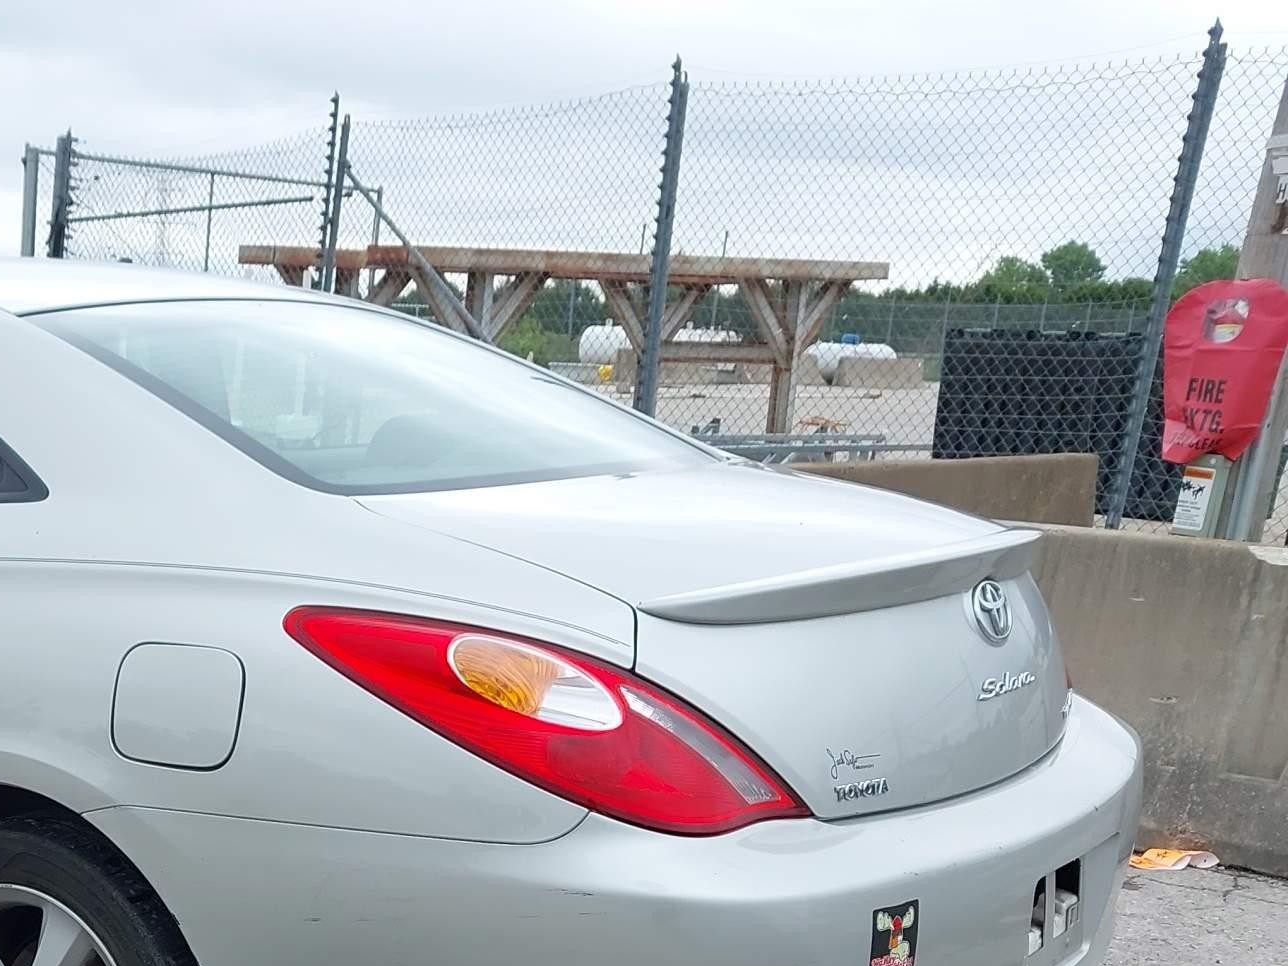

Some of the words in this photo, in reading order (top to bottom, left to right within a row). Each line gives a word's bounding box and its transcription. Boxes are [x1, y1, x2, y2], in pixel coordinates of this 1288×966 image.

[1186, 377, 1227, 404] FIRE
[976, 671, 1035, 701] Solara
[834, 778, 889, 801] TOYOTA
